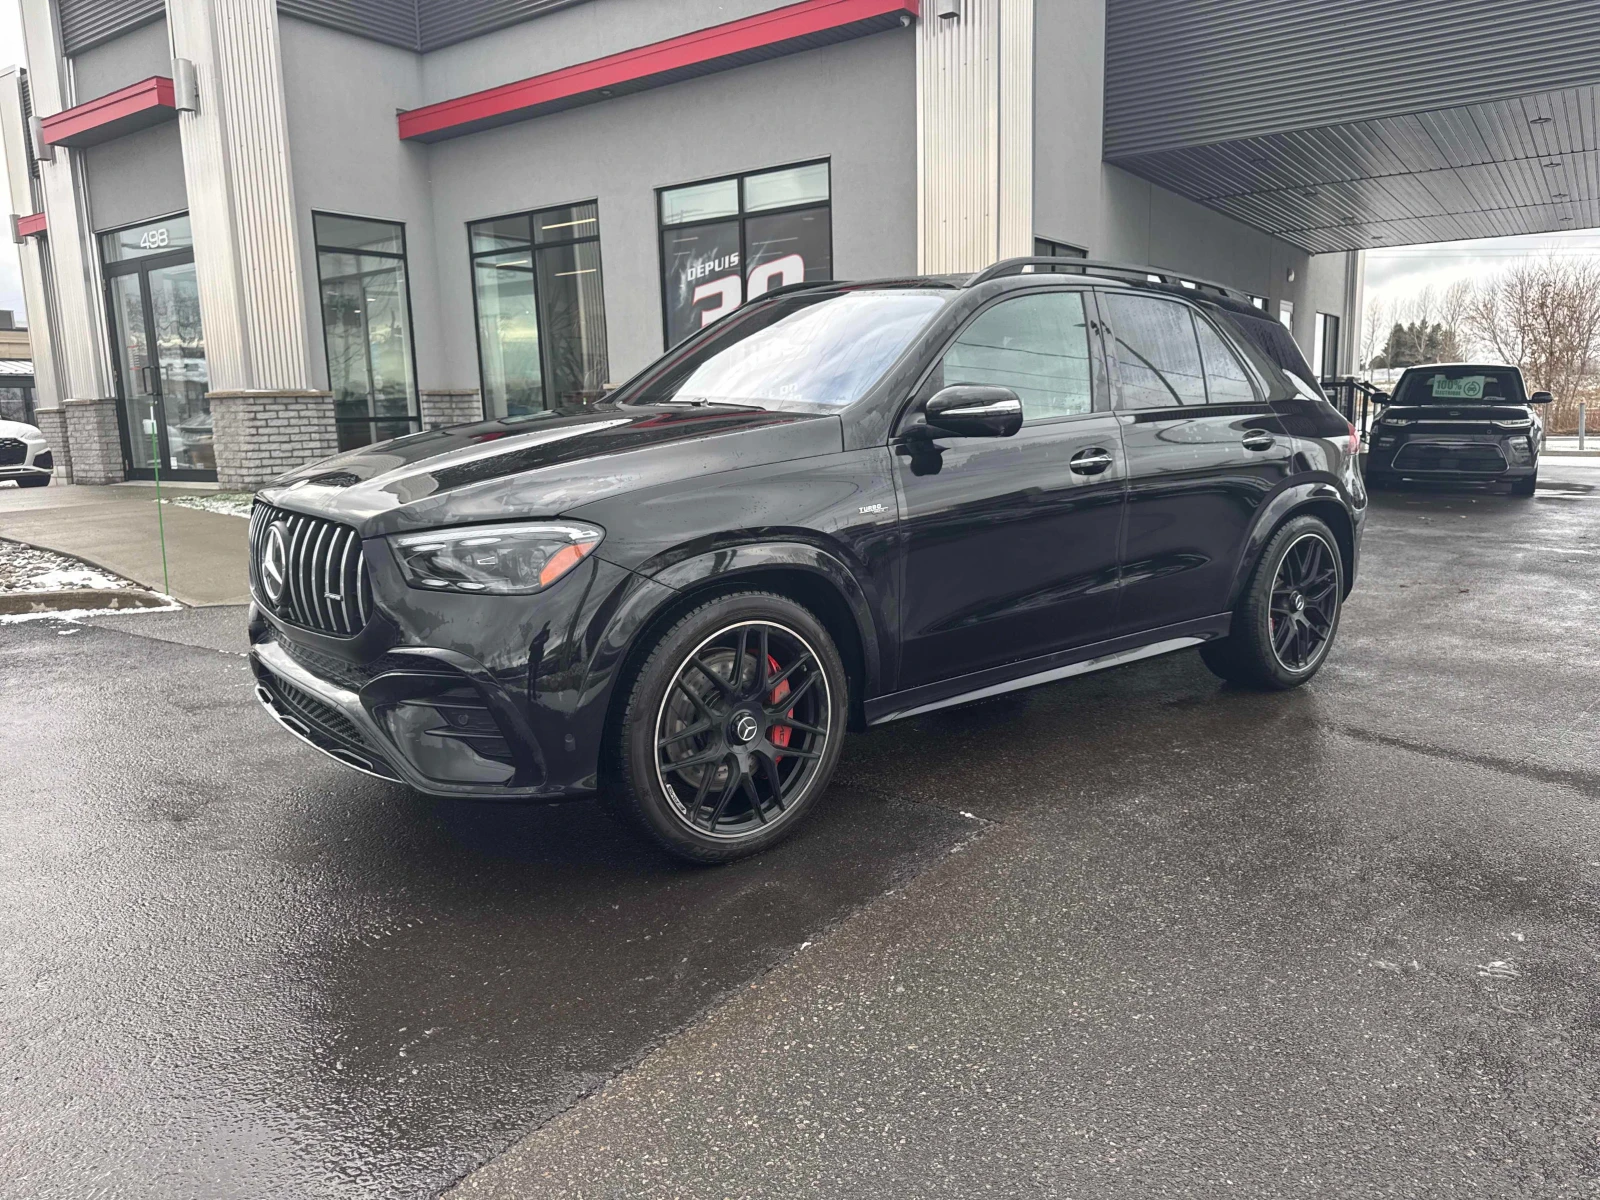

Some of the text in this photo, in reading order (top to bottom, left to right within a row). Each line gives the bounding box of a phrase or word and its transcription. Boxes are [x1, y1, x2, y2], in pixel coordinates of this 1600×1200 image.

[140, 228, 168, 249] 498
[687, 252, 740, 281] DEPUIS
[1436, 380, 1462, 390] 100%
[858, 503, 882, 514] TURBO
